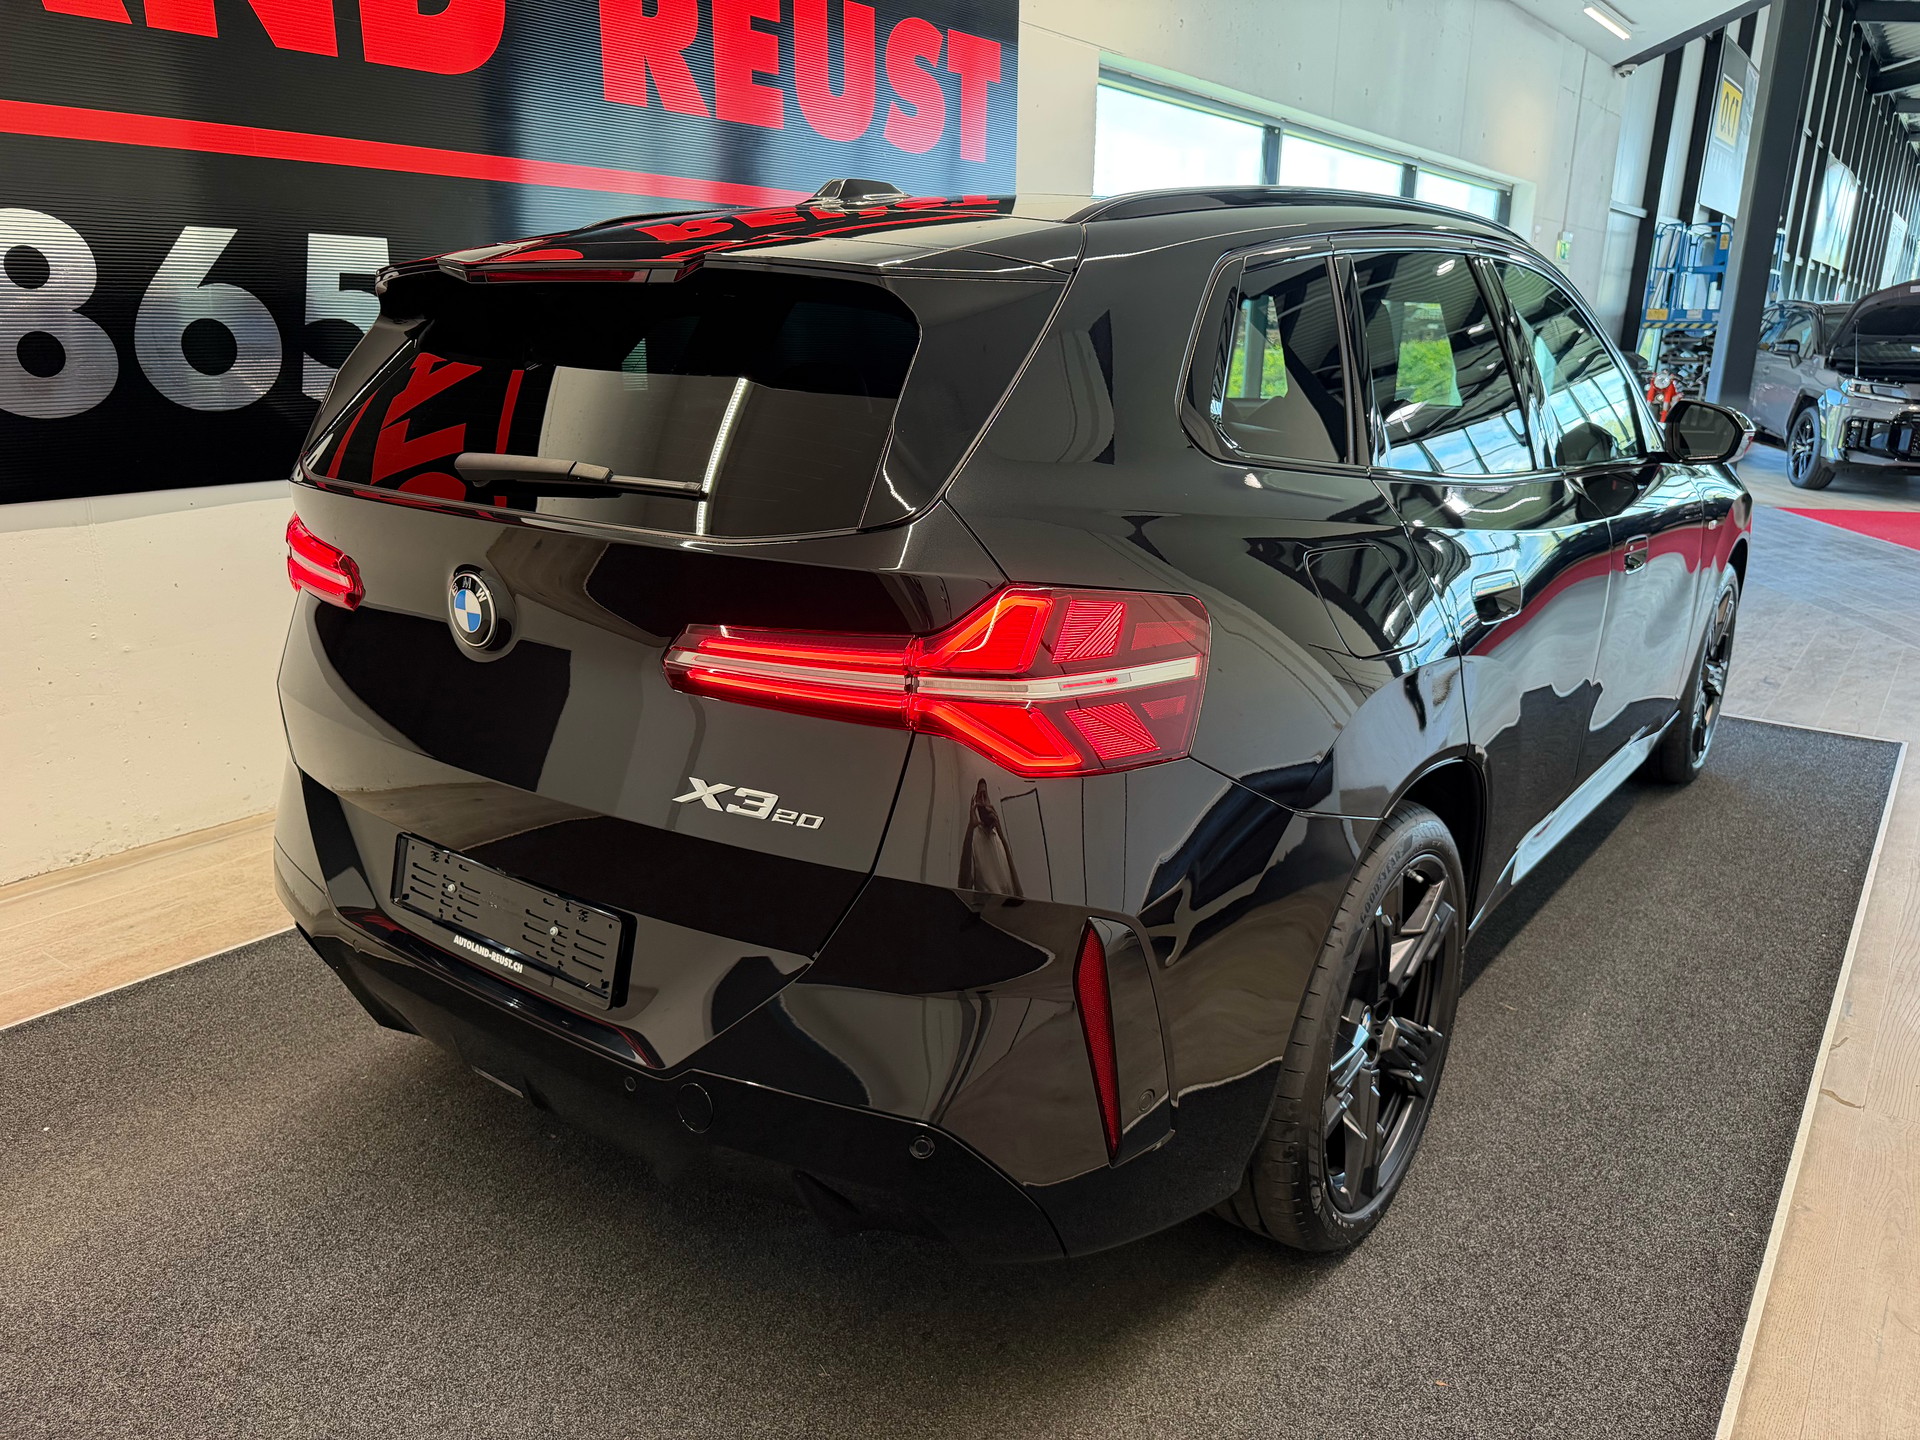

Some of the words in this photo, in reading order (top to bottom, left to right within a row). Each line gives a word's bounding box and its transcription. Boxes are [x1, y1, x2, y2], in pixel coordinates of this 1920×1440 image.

[600, 0, 1000, 163] REUST
[451, 576, 487, 603] BMW
[453, 934, 524, 974] AUTOLAND-REUST.CH
